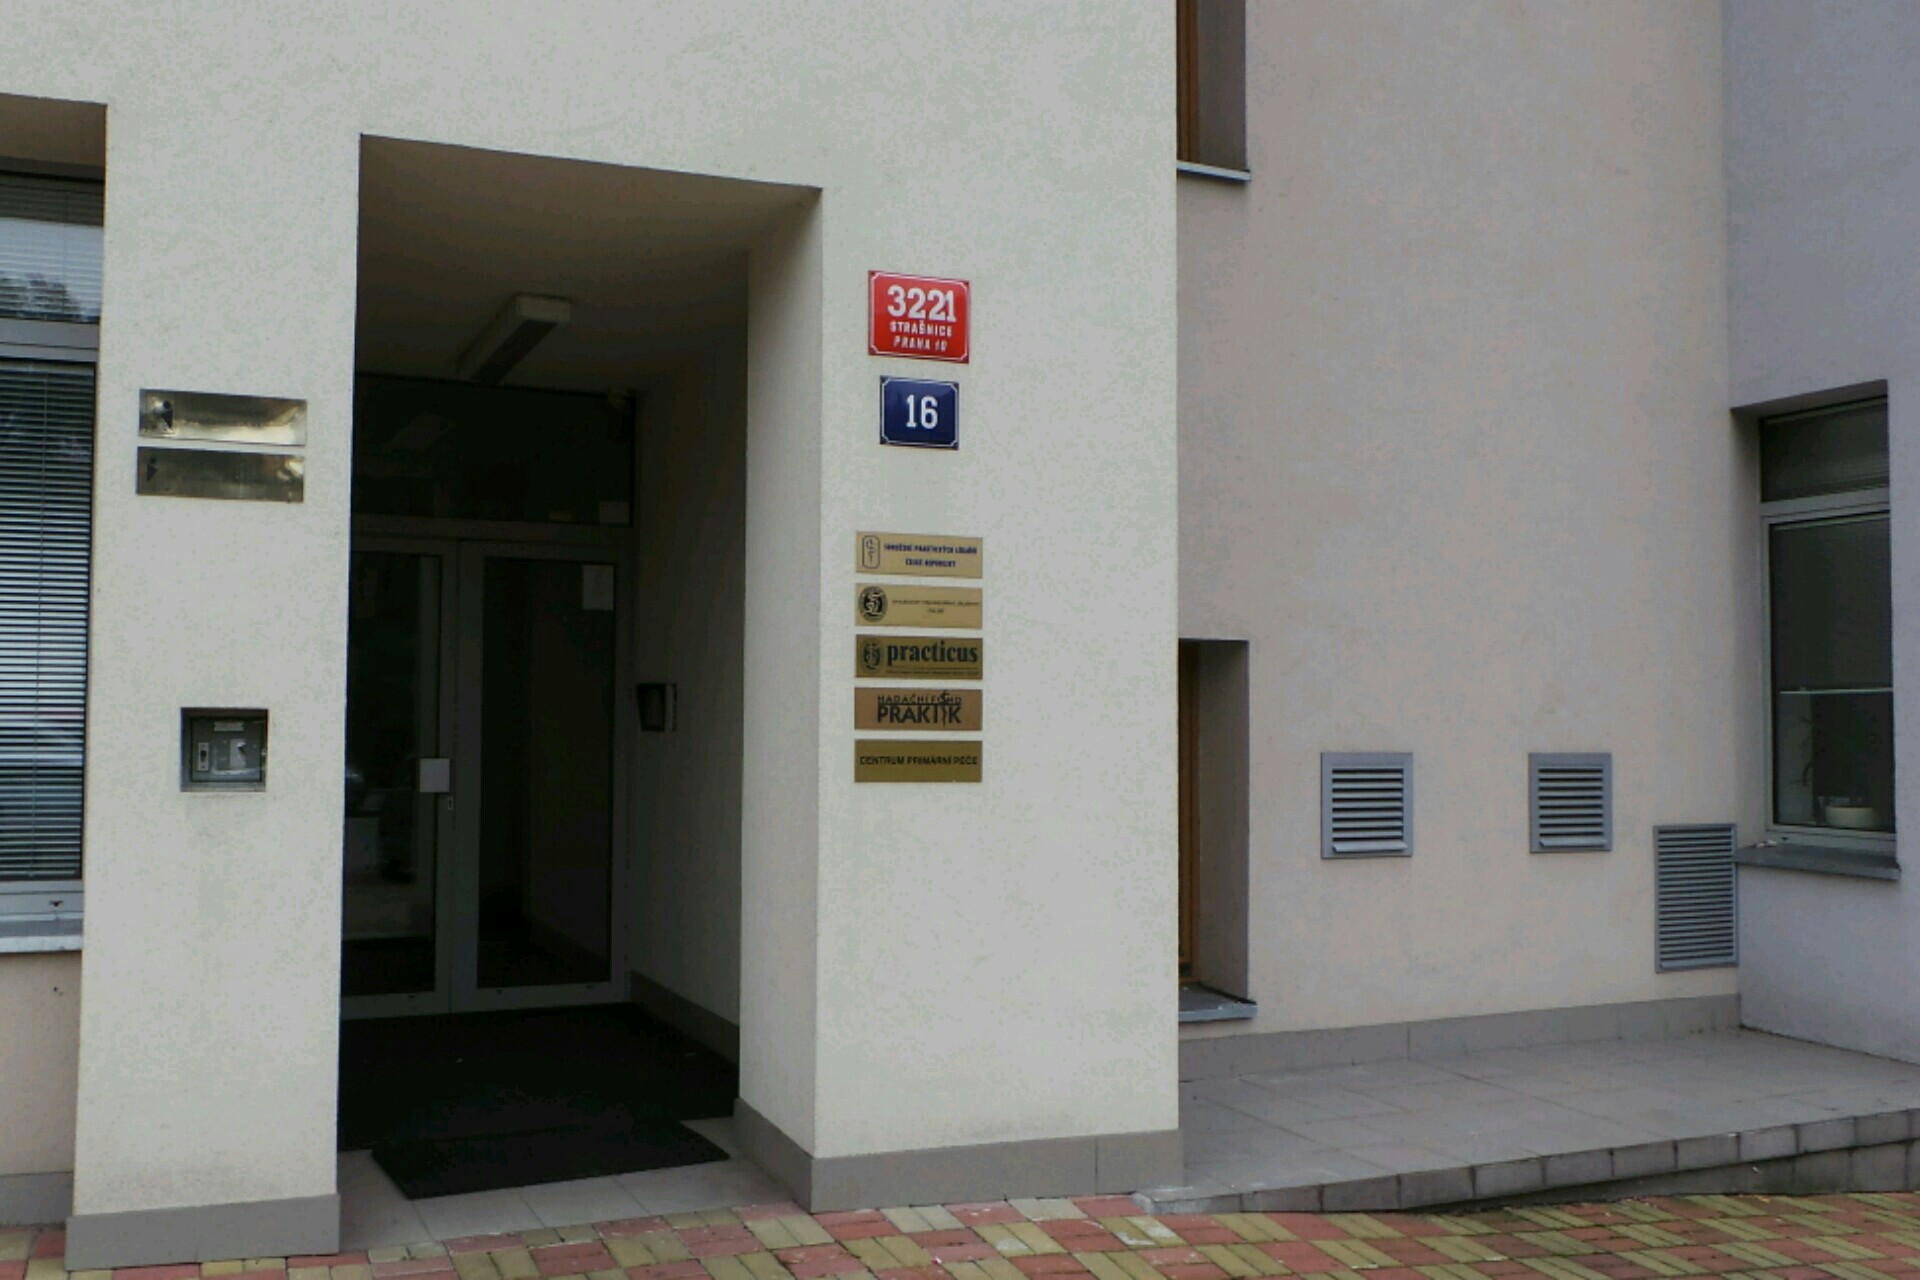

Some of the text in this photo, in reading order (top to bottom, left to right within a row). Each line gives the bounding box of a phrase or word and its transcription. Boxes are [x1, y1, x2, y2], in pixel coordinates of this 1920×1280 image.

[887, 284, 957, 322] 3221
[889, 320, 951, 336] STRAŠNICE
[893, 335, 930, 350] PRAHA
[905, 394, 938, 430] 16
[887, 640, 977, 666] practicus
[860, 756, 904, 765] CENTRUM
